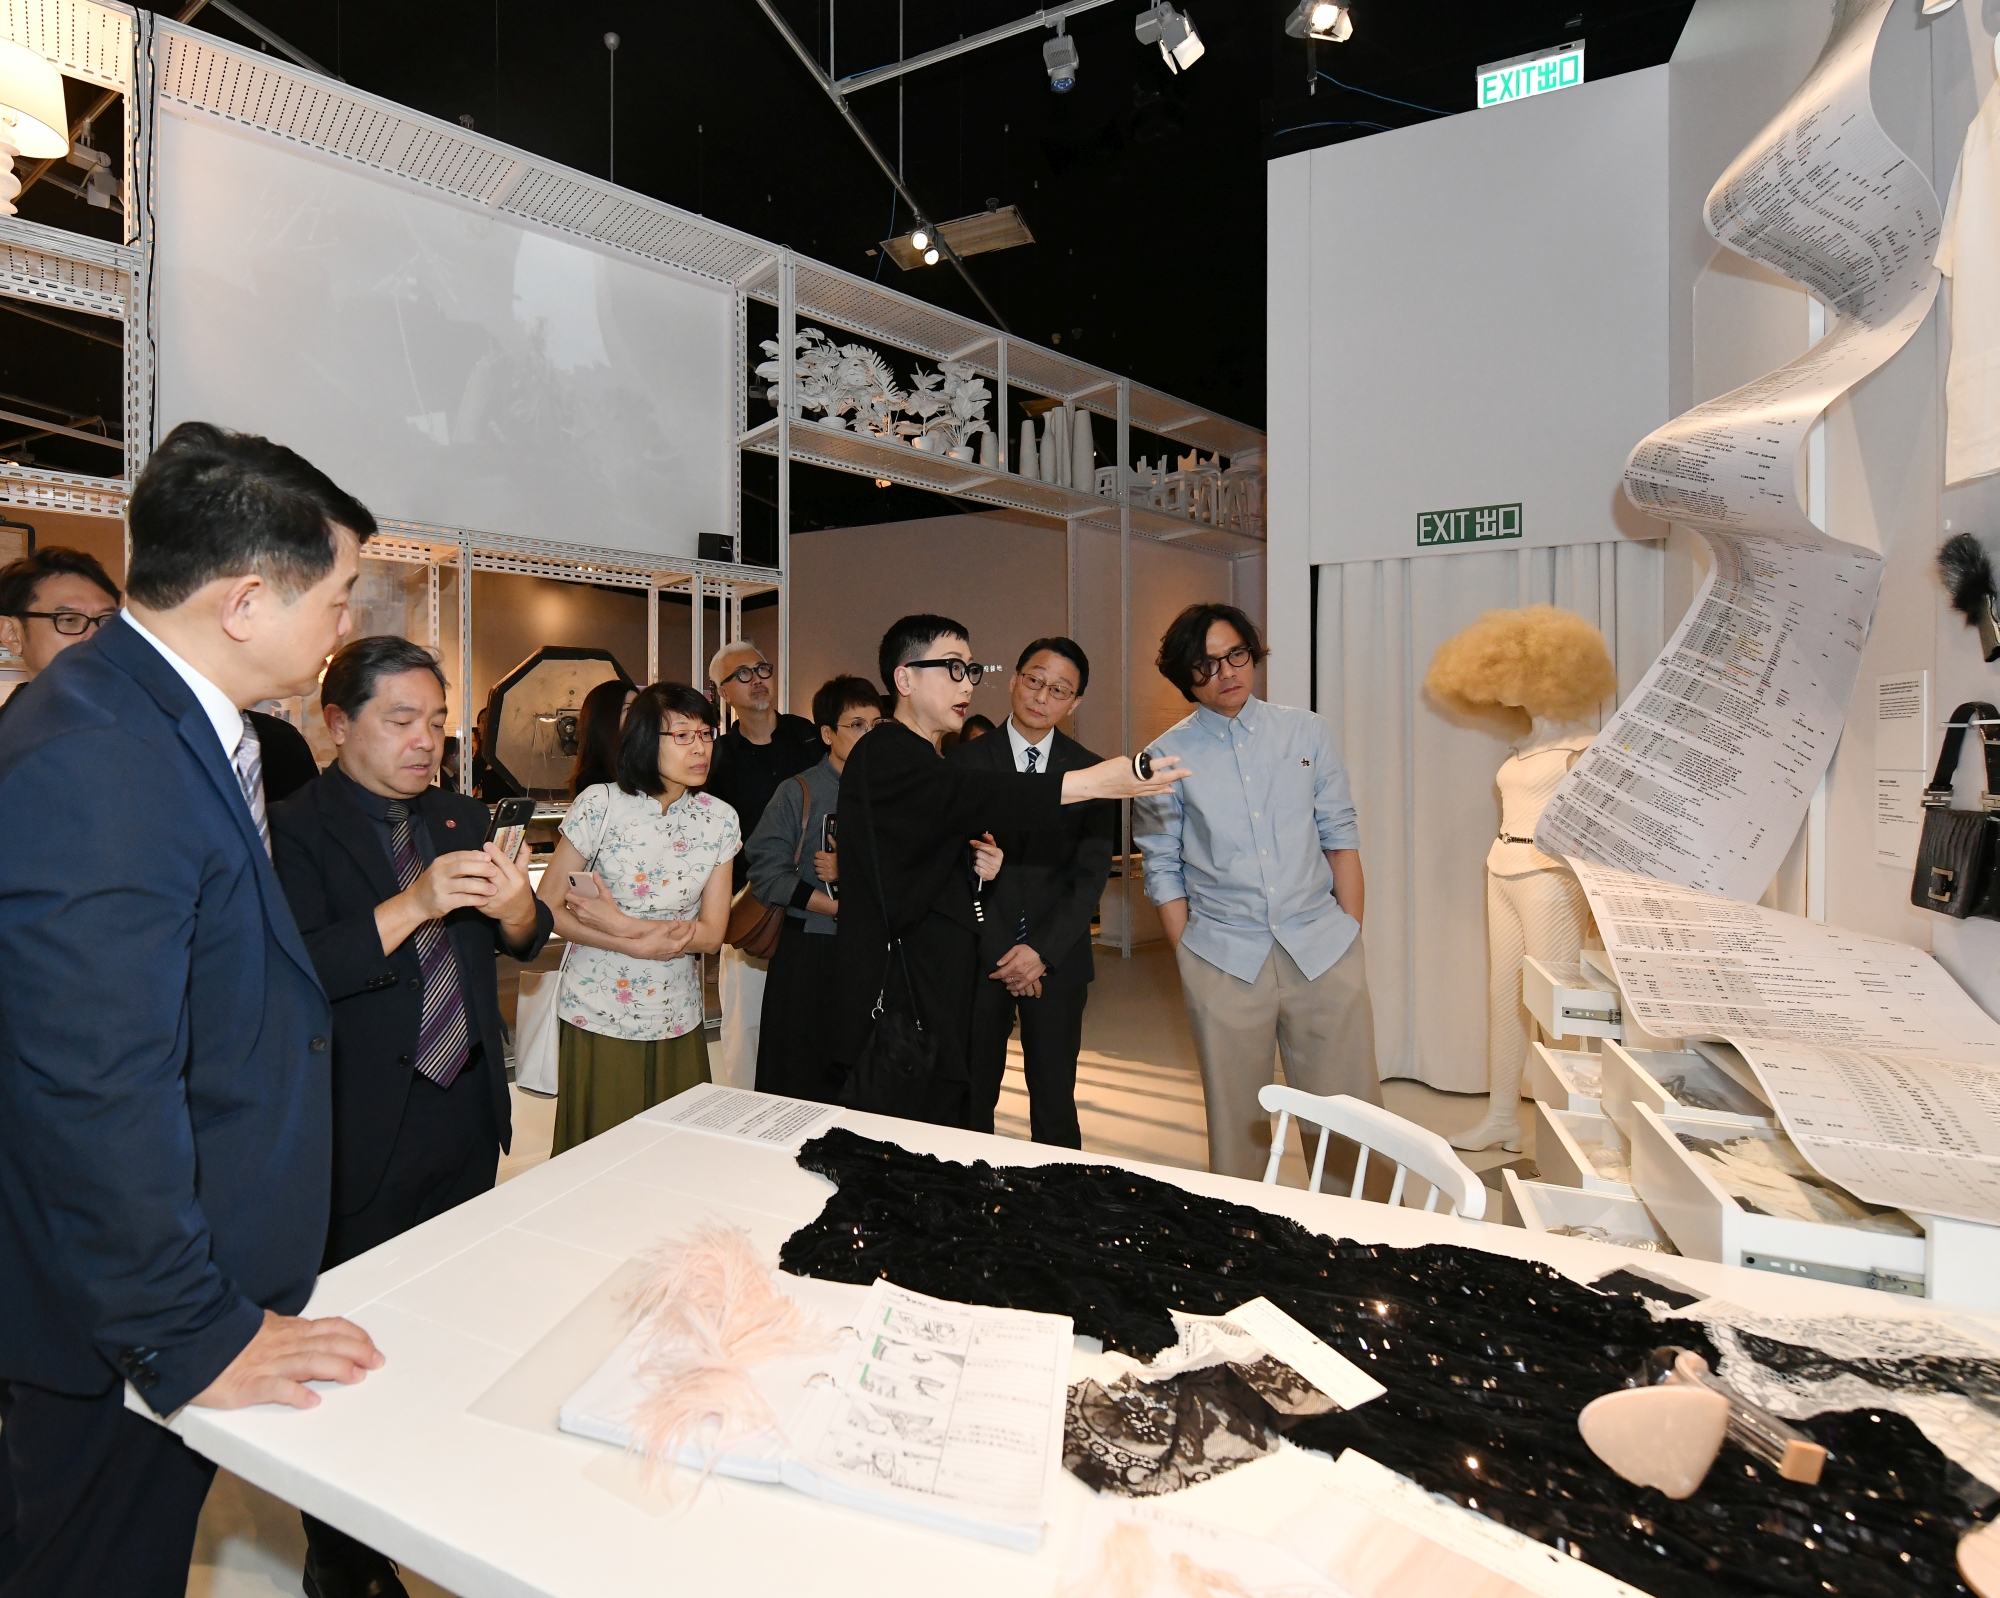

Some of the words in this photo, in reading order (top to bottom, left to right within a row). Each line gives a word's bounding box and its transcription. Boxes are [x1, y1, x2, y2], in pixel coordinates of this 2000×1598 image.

[1483, 65, 1536, 105] EXIT
[1537, 55, 1578, 92] 出口
[1420, 511, 1470, 543] EXIT
[1475, 506, 1519, 538] 出口
